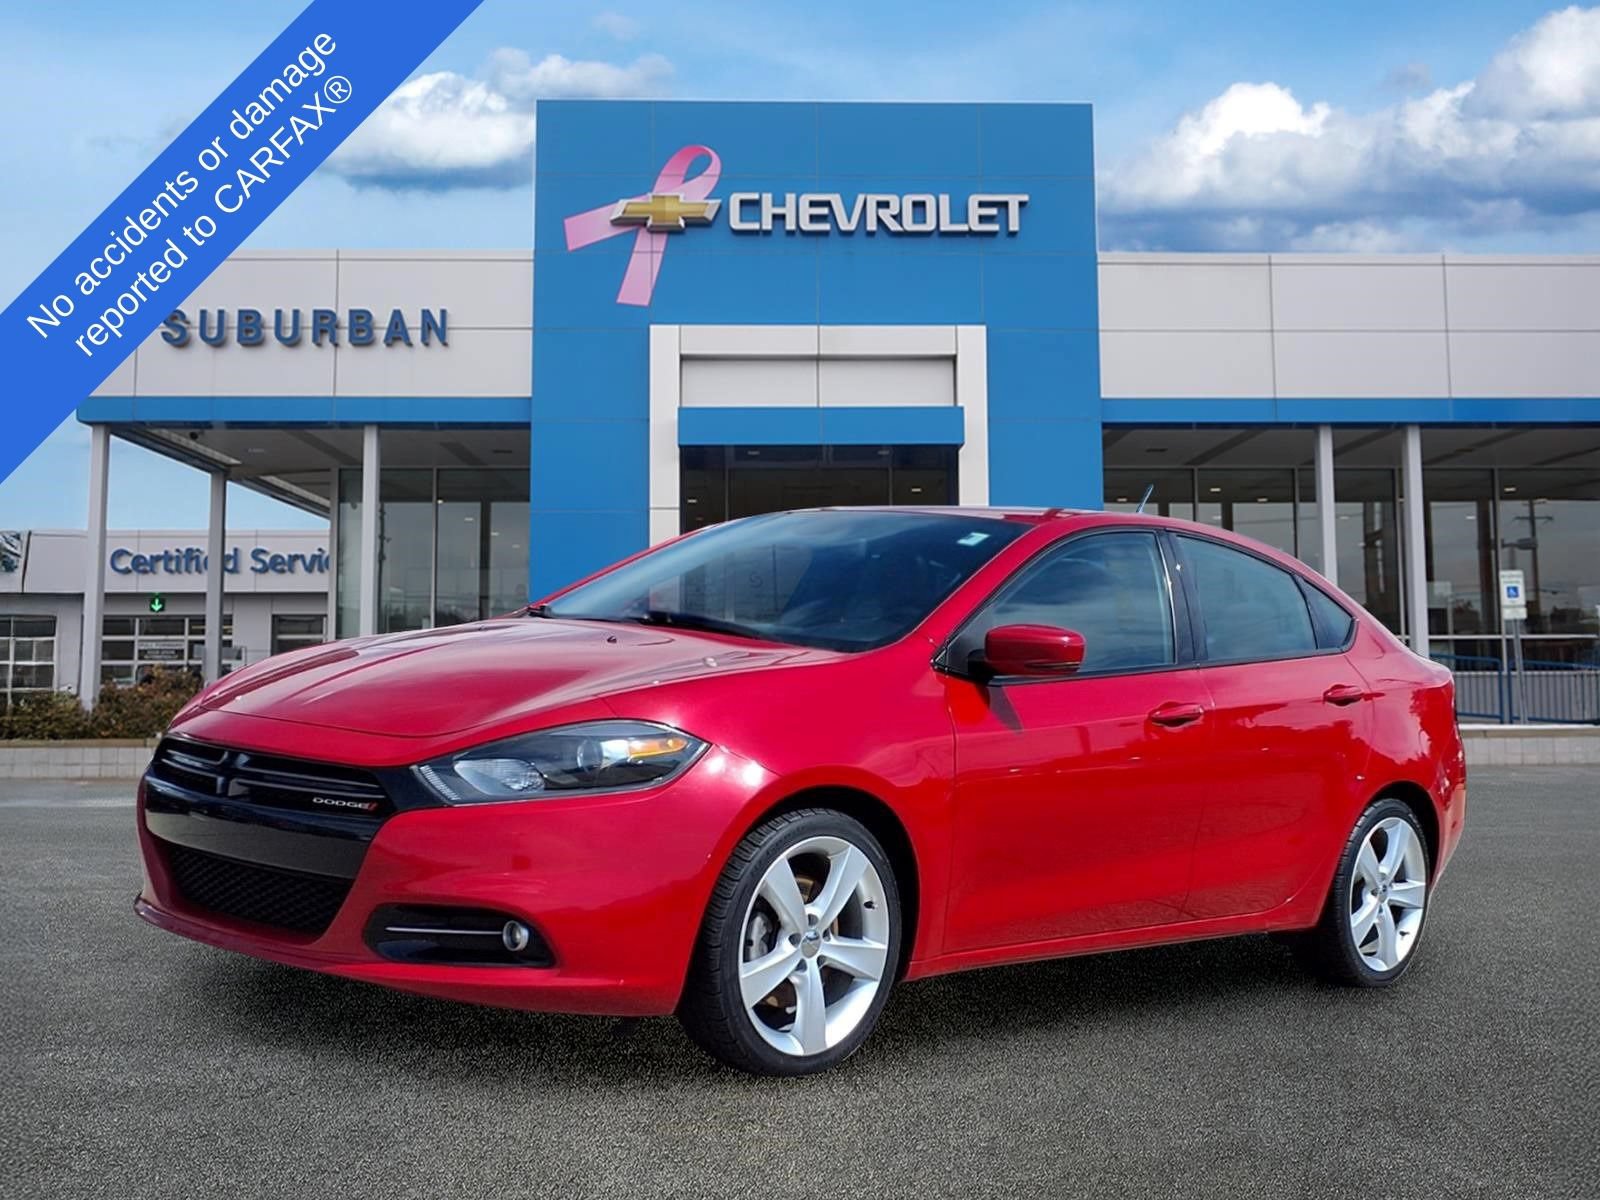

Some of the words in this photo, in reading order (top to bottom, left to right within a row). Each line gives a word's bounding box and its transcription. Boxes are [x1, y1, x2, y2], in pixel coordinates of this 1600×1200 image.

[728, 193, 1029, 234] CHEVROLET
[161, 308, 448, 347] SUBURBAN
[312, 797, 370, 810] DODGE
